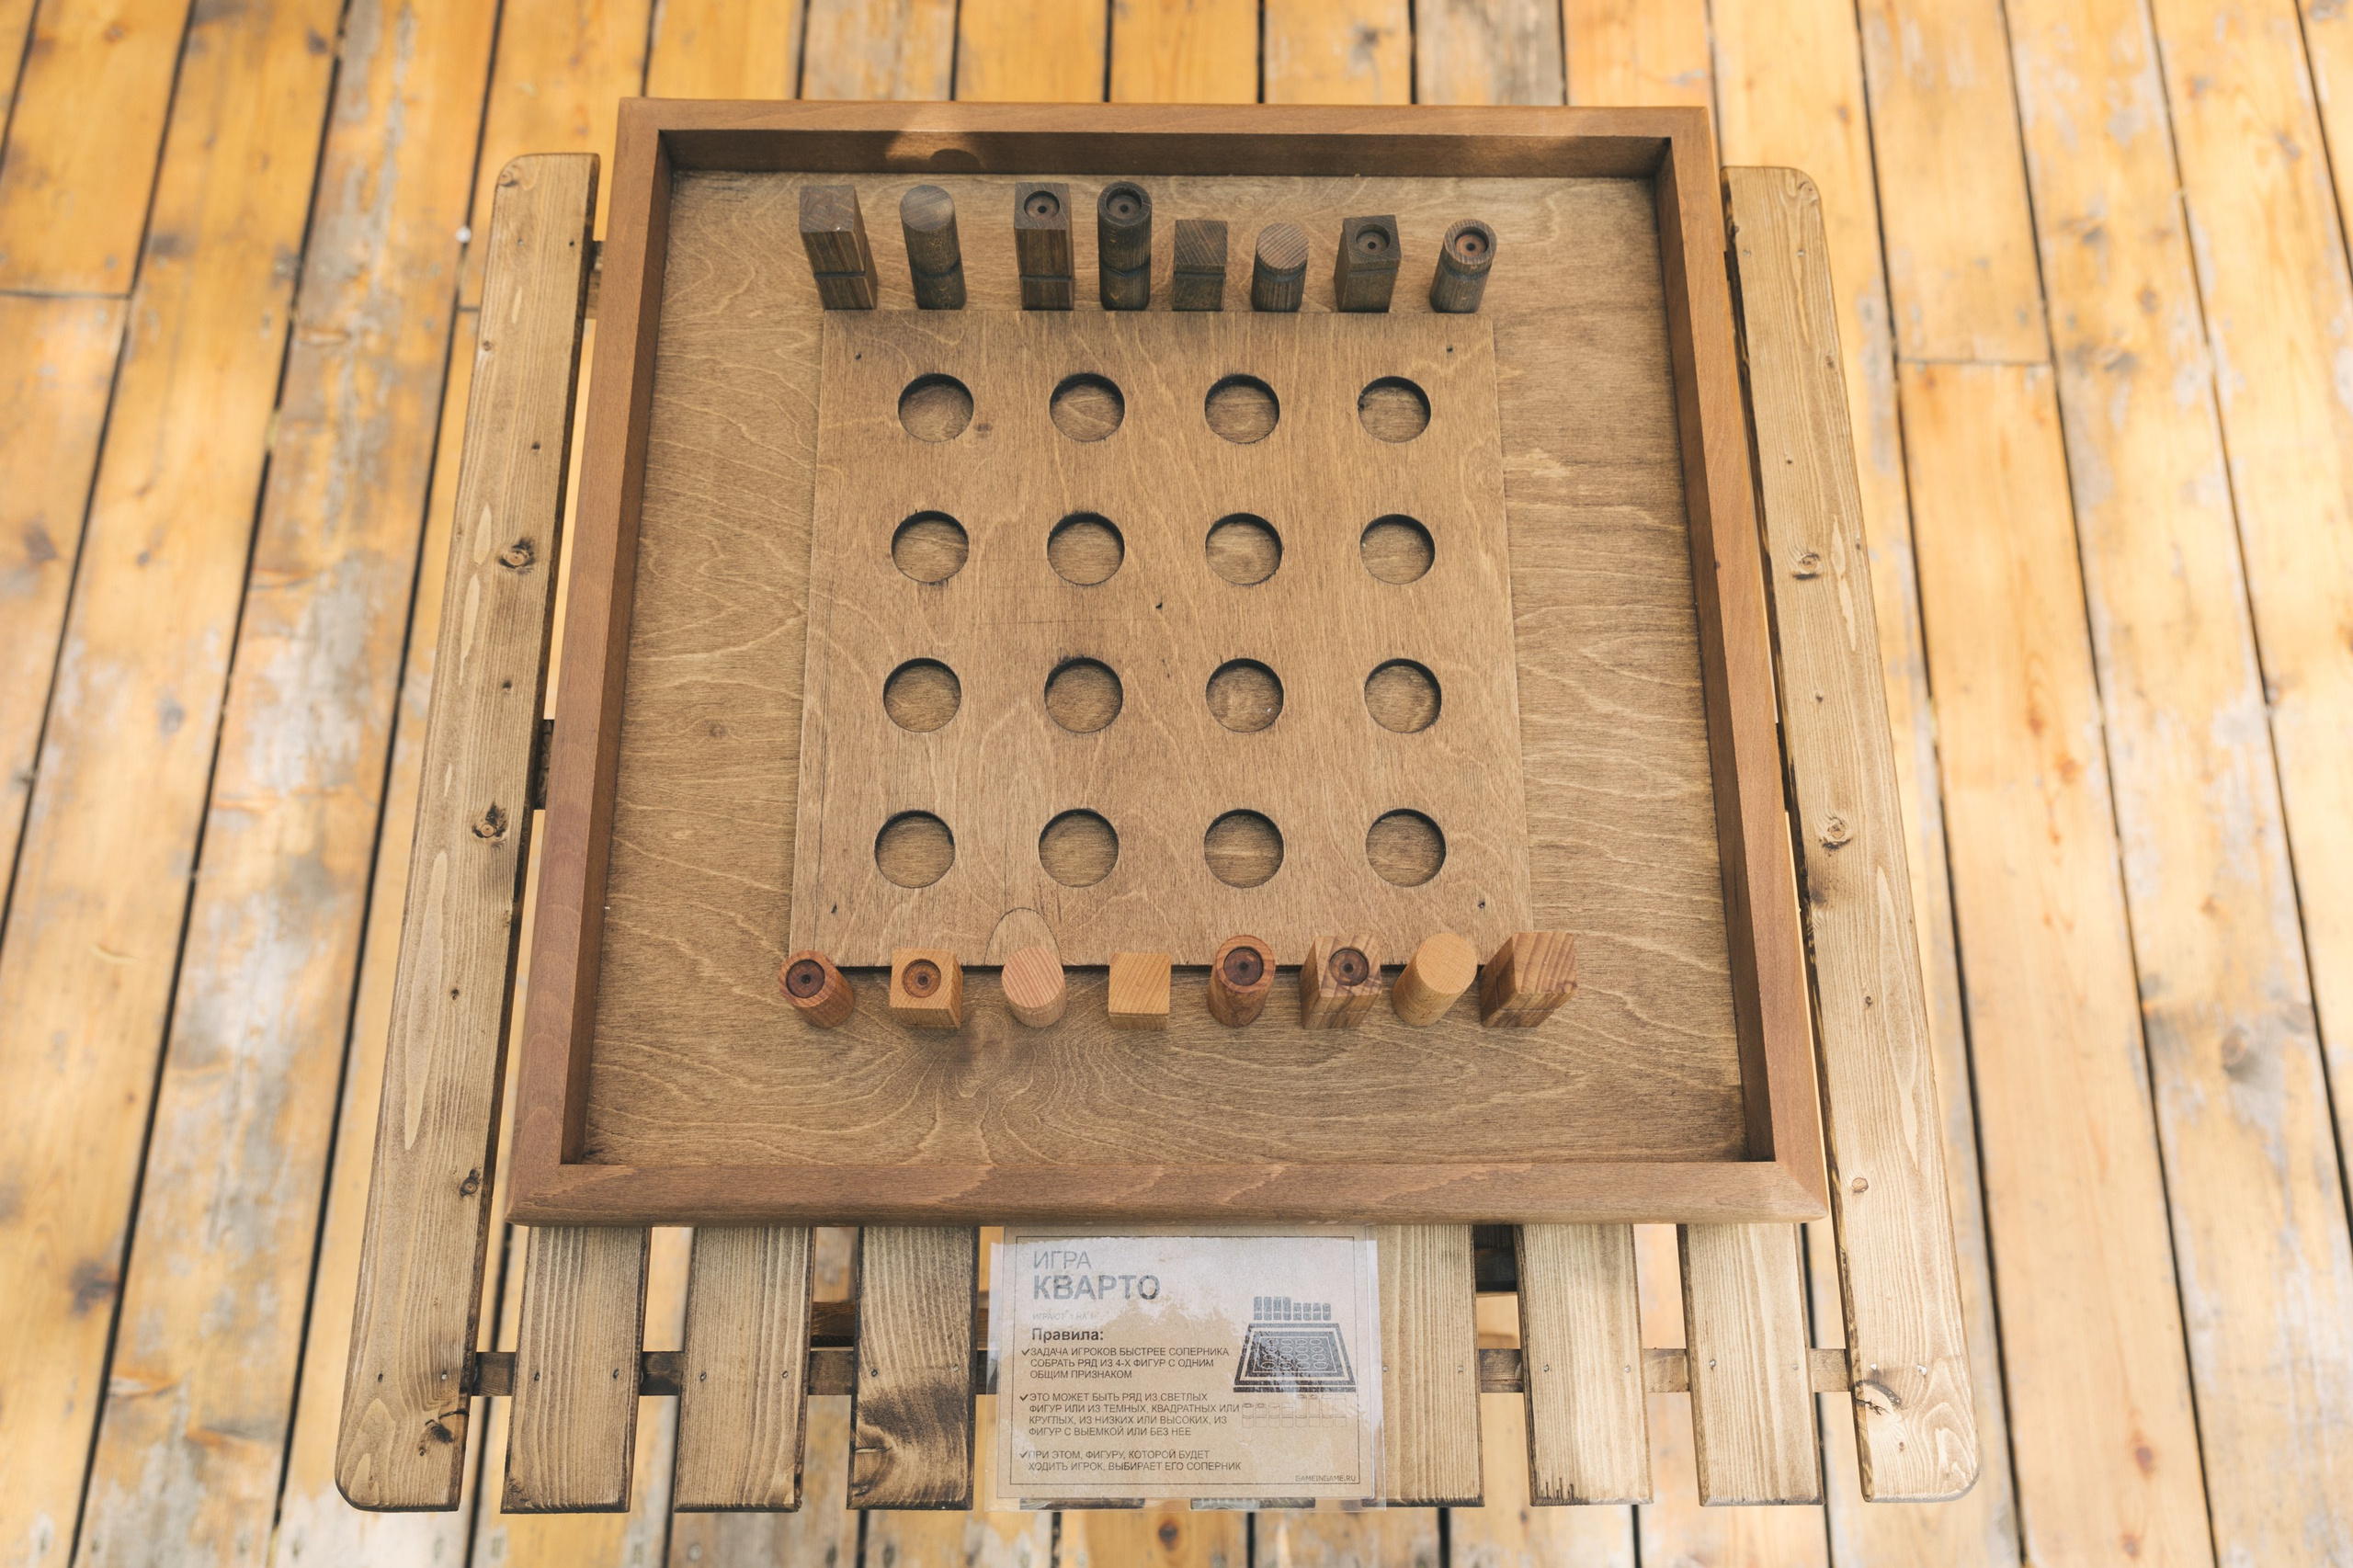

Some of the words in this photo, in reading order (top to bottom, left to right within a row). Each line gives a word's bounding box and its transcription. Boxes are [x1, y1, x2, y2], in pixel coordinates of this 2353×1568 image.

[1033, 1251, 1092, 1269] ИГРА
[1033, 1275, 1161, 1300] КВАРТО
[1032, 1328, 1104, 1344] Правила:
[1030, 1347, 1068, 1357] ЗАДАЧА
[1072, 1347, 1117, 1356] ИГРОКОВ
[1120, 1347, 1166, 1356] БЫСТРЕЕ
[1169, 1347, 1229, 1356] СОПЕРНИКА
[1030, 1358, 1074, 1368] СОБРАТЬ
[1077, 1359, 1097, 1369] РЯД
[1133, 1359, 1165, 1368] ФИГУР
[1177, 1359, 1213, 1369] ОДНИМ
[1030, 1370, 1068, 1380] ОБЩИМ
[1071, 1370, 1131, 1379] ПРИЗНАКОМ
[1029, 1393, 1050, 1402] ЭТО
[1122, 1393, 1142, 1403] РЯД
[1029, 1404, 1062, 1413] ФИГУР
[1064, 1404, 1085, 1413] ИЛИ
[1087, 1404, 1100, 1413] ИЗ
[1104, 1404, 1149, 1415] ТЕМНЫХ,
[1152, 1404, 1216, 1414] КВАДРАТНЫХ
[1219, 1404, 1240, 1413] ИЛИ
[1029, 1416, 1076, 1426] КРУГЛЫХ,
[1079, 1416, 1092, 1425] ИЗ
[1096, 1416, 1133, 1425] НИЗКИХ
[1137, 1416, 1157, 1425] ИЛИ
[1160, 1416, 1211, 1426] ВЫСОКИХ,
[1214, 1416, 1227, 1425] ИЗ
[1029, 1427, 1062, 1436] ФИГУР
[1064, 1427, 1072, 1436] С
[1074, 1426, 1124, 1436] ВЫЕМКОЙ
[1127, 1427, 1147, 1436] ИЛИ
[1151, 1427, 1168, 1436] БЕЗ
[1172, 1427, 1191, 1436] НЕЕ
[1029, 1450, 1049, 1459] ПРИ
[1051, 1450, 1084, 1460] ЭТОМ,
[1086, 1450, 1126, 1460] ФИГУРУ,
[1129, 1449, 1176, 1459] КОТОРОЙ
[1179, 1450, 1210, 1460] БУДЕТ
[1029, 1462, 1068, 1471] ХОДИТЬ
[1071, 1462, 1105, 1471] ИГРОК,
[1108, 1462, 1162, 1471] ВЫБИРАЕТ
[1165, 1462, 1184, 1471] ЕГО
[1187, 1462, 1241, 1471] СОПЕРНИК
